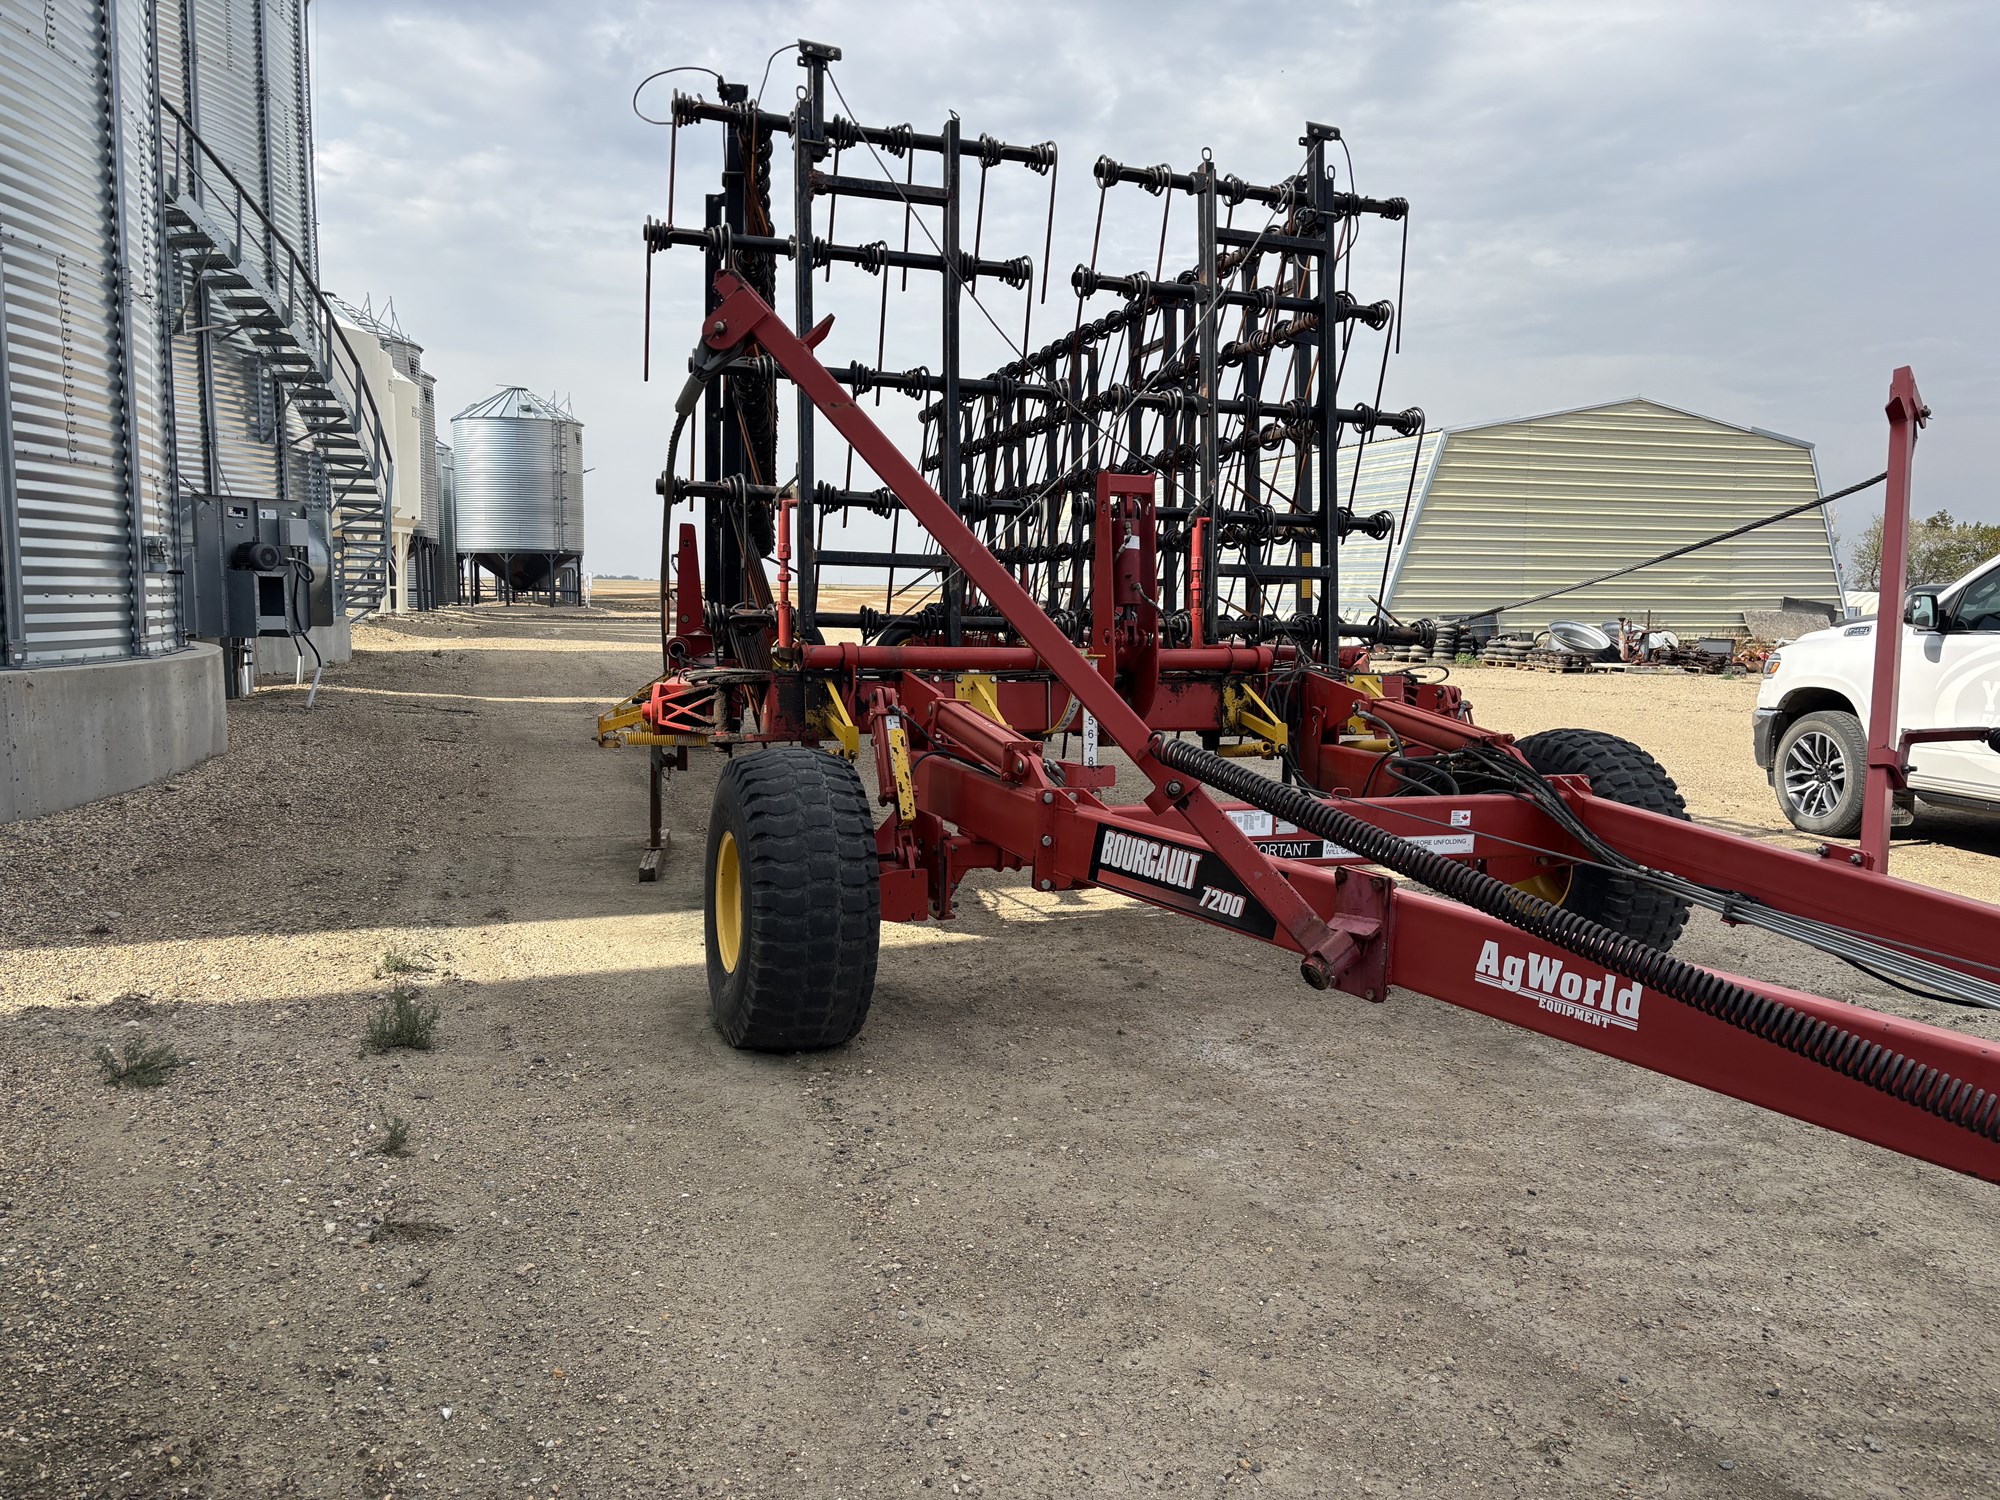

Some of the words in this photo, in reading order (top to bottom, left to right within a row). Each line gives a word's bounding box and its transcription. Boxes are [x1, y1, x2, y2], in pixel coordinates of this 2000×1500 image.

[1088, 716, 1094, 725] 5
[1088, 730, 1094, 739] 6
[1088, 743, 1093, 752] 7
[1088, 757, 1094, 766] 8
[1433, 838, 1467, 846] UNFOLDING
[1254, 843, 1311, 857] ORTANT
[1100, 830, 1202, 890] BOURGAULT
[1199, 885, 1246, 918] 7200
[1475, 939, 1643, 1020] AgWorld
[1538, 998, 1611, 1029] EQUIPMENT
